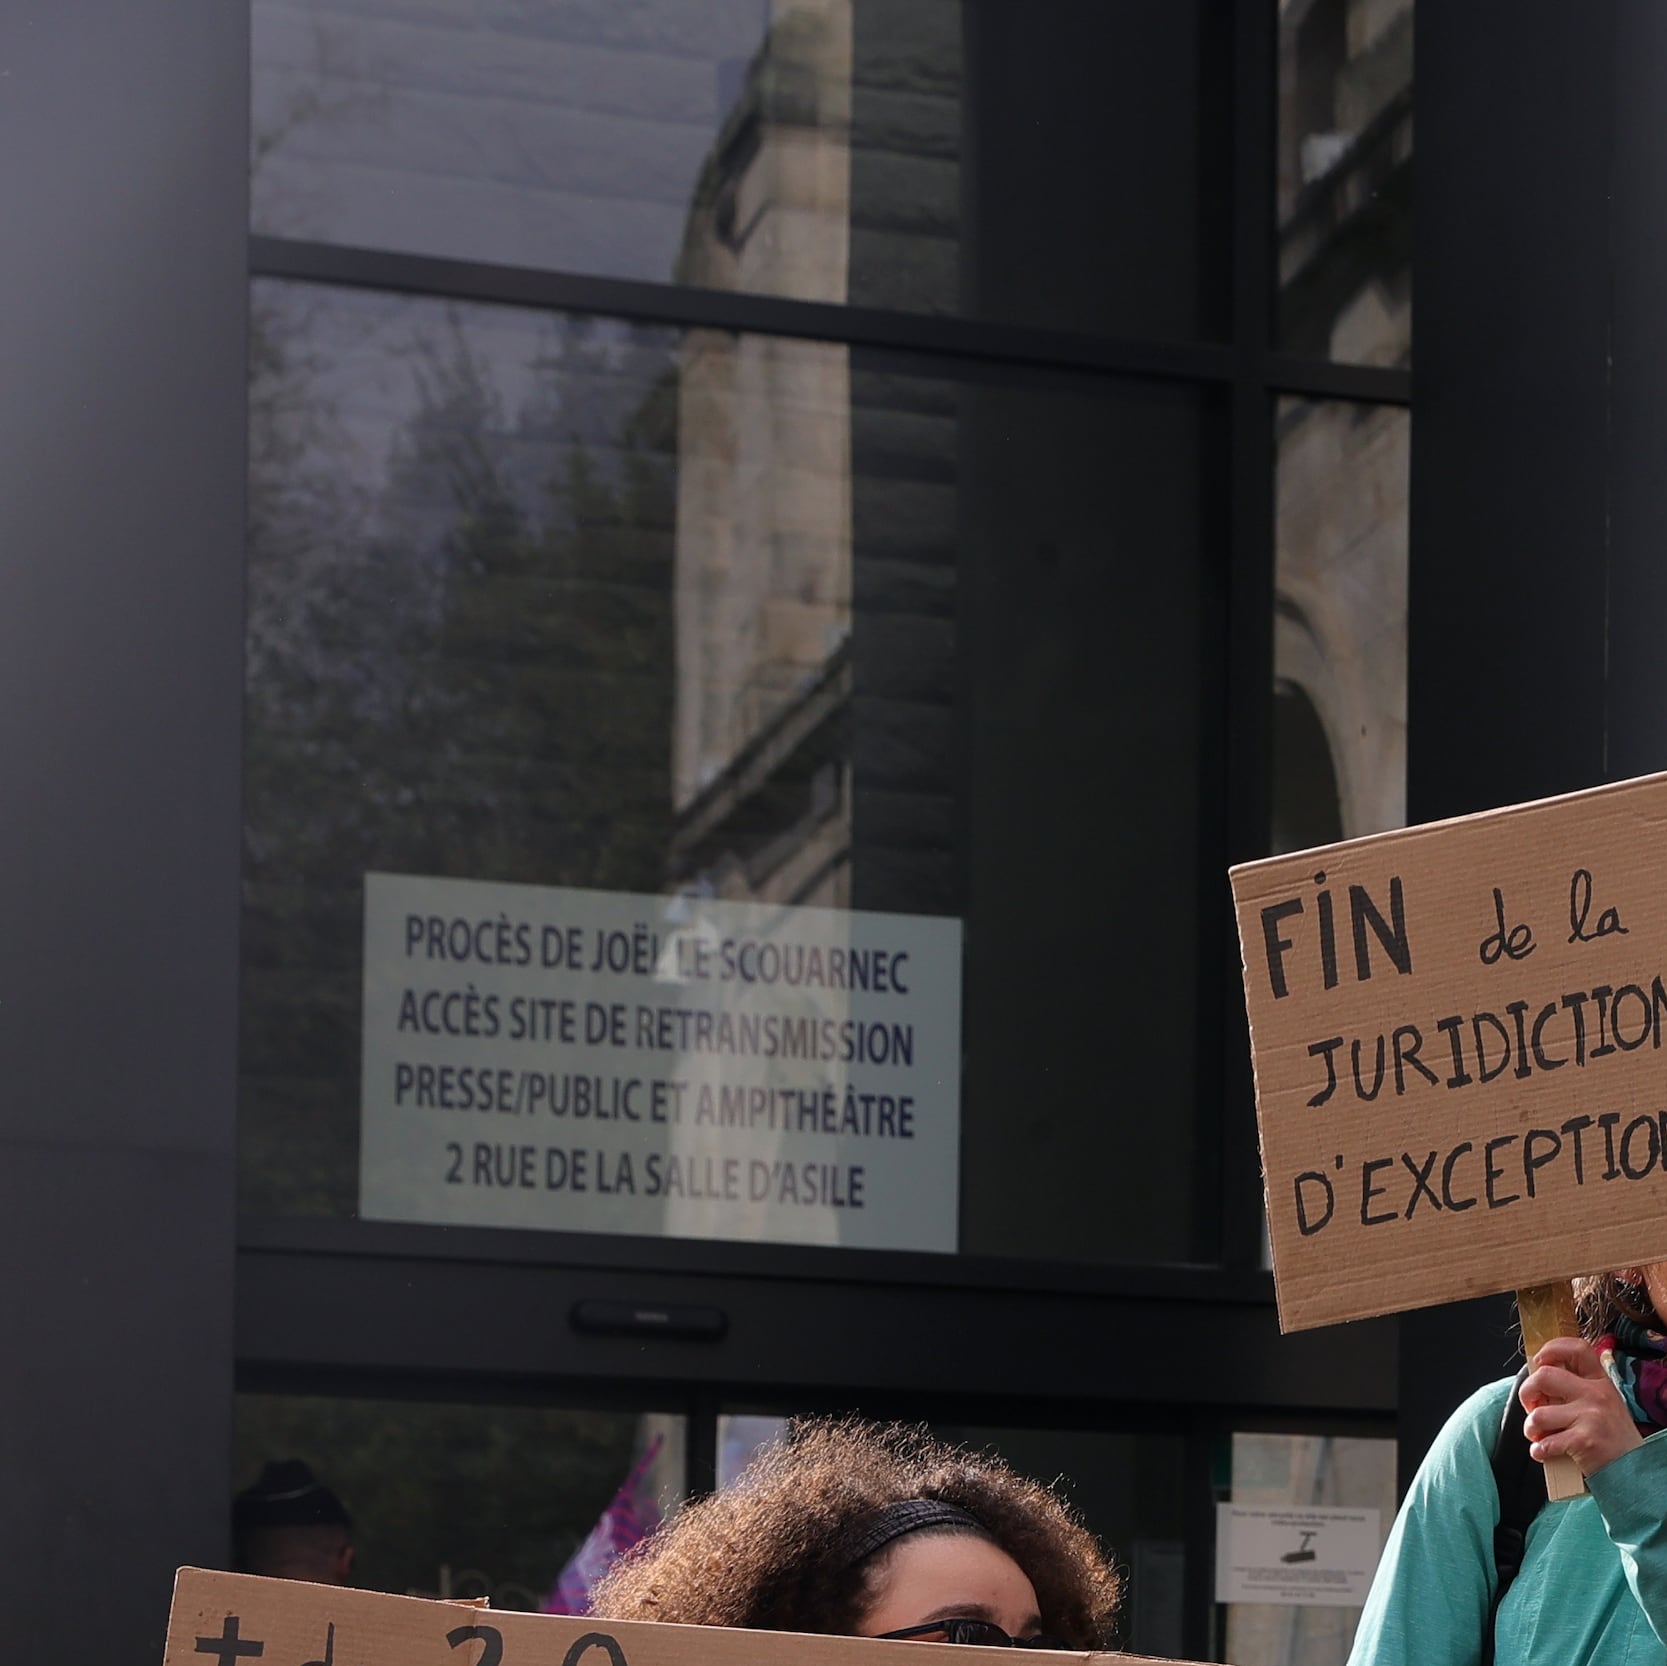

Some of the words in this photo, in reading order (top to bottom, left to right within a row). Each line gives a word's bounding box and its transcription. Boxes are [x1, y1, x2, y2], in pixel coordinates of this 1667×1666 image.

[405, 912, 531, 966] PROCÈS
[541, 927, 584, 971] DE
[592, 922, 662, 977] JOËL
[678, 936, 710, 980] LE
[720, 938, 910, 994] SCOUARNEC
[1260, 871, 1413, 999] FIN
[1479, 888, 1536, 965] de
[1567, 869, 1629, 944] la
[398, 983, 501, 1037] ACCÈS
[508, 995, 577, 1043] SITE
[585, 1003, 627, 1047] DE
[636, 1006, 914, 1067] RETRANSMISSION
[395, 1063, 642, 1123] PRESSE/PUBLIC
[650, 1080, 688, 1125] ET
[444, 1142, 464, 1185] 2
[473, 1143, 536, 1189] RUE
[547, 1149, 587, 1192] DE
[596, 1152, 635, 1195] LA
[645, 1153, 740, 1202] SALLE
[749, 1160, 865, 1209] D'ASILE
